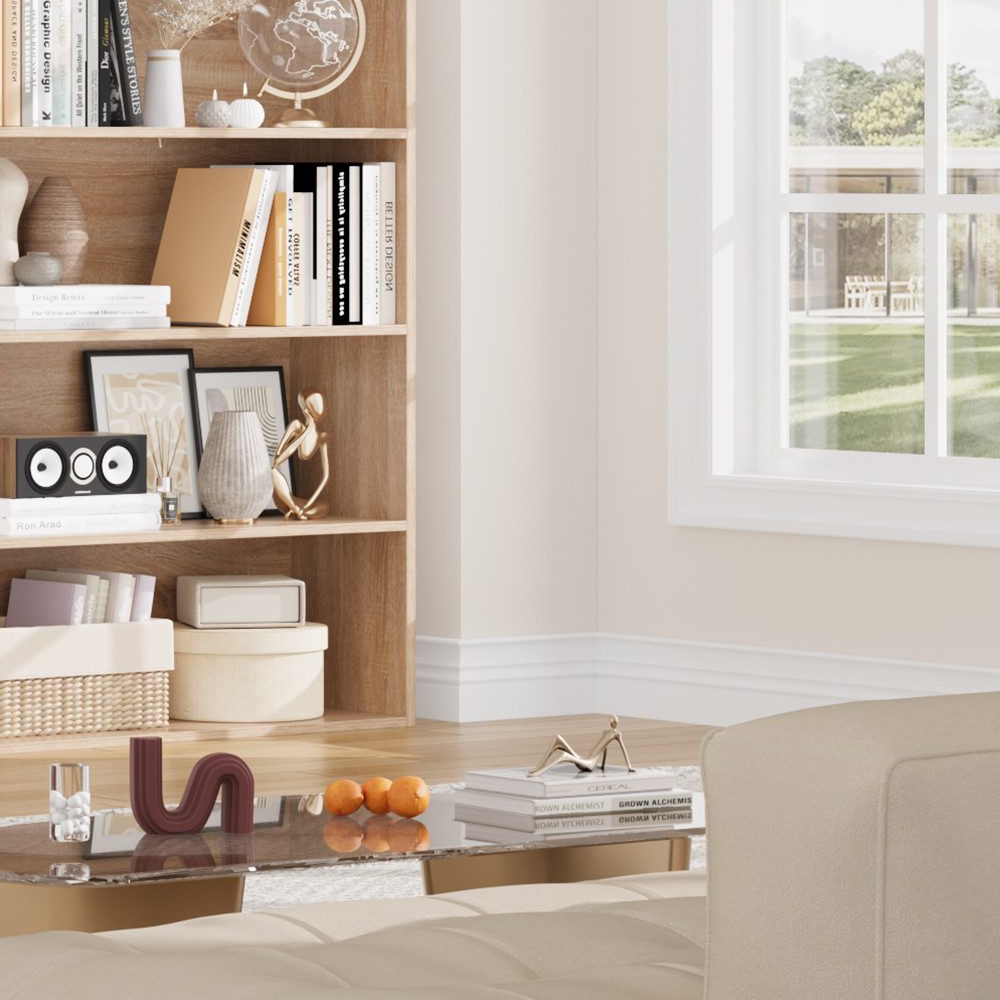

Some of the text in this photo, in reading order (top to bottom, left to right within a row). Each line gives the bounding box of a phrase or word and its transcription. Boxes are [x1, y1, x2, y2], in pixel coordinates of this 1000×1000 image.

[41, 0, 51, 93] Graphic Design
[101, 51, 109, 69] Dior
[121, 27, 136, 65] STYLE
[127, 65, 142, 115] STORIES
[231, 219, 251, 278] MINIMALISM
[16, 521, 36, 530] Ron
[39, 521, 61, 529] Arad
[618, 796, 692, 808] GROWN ALCHEMIS
